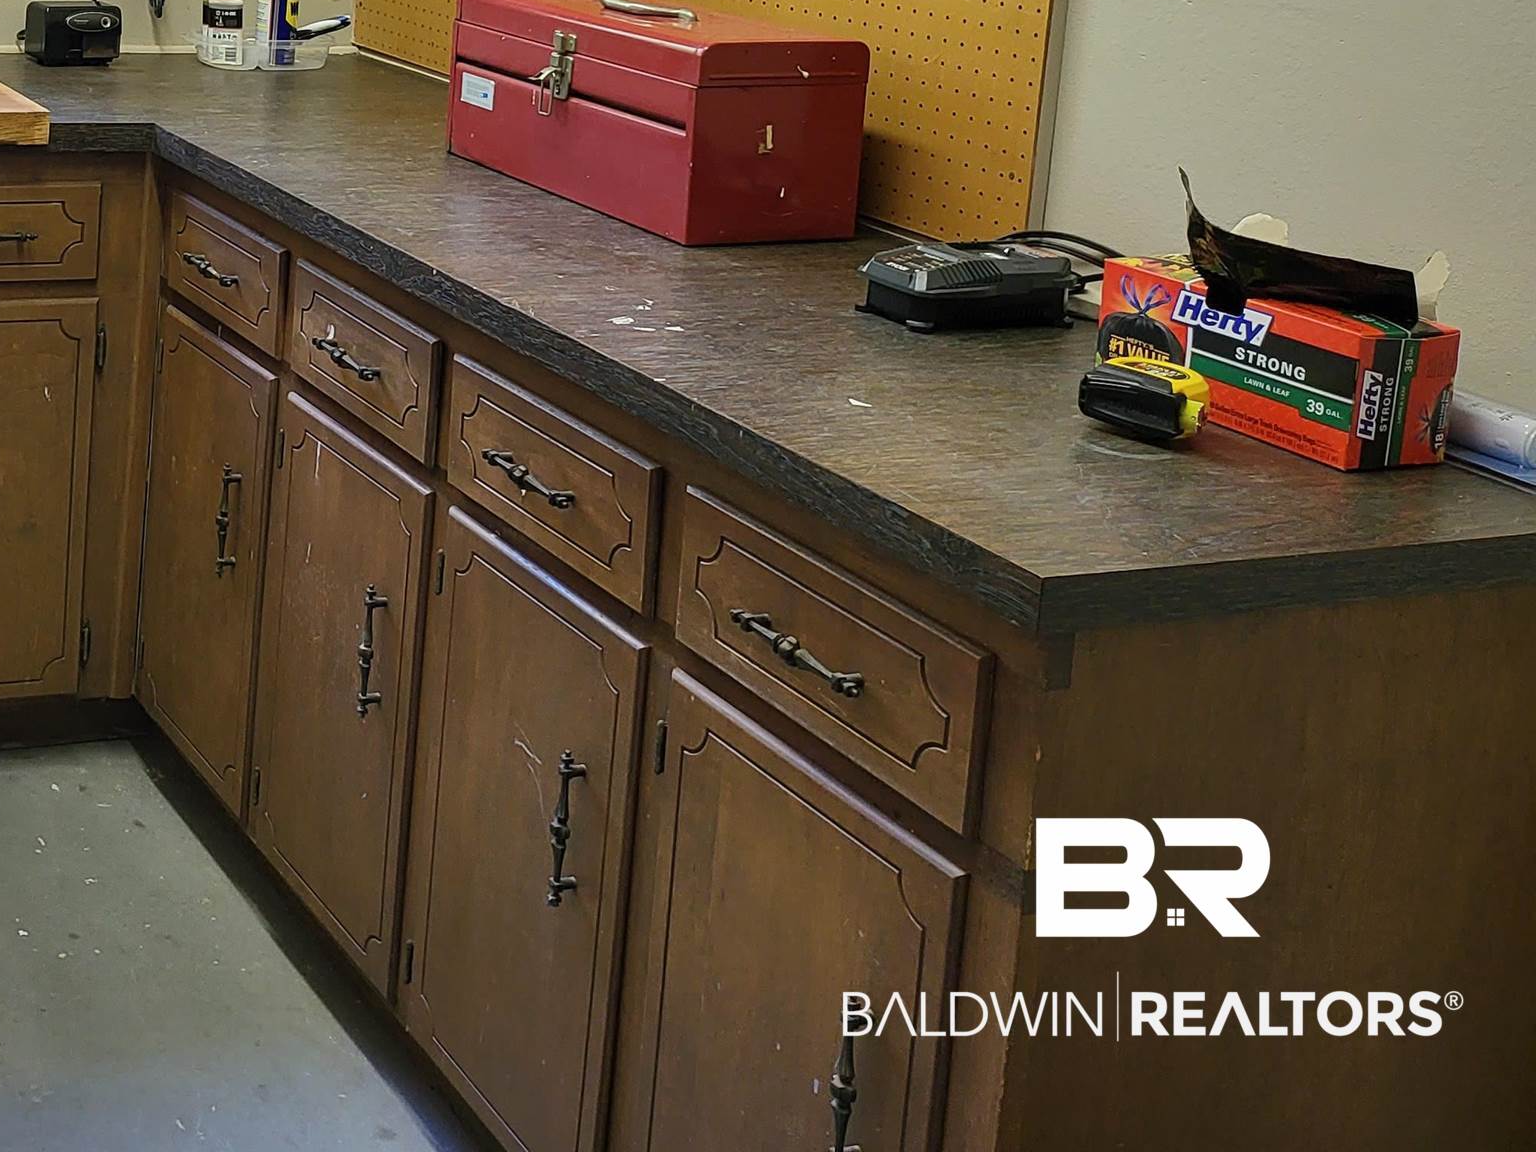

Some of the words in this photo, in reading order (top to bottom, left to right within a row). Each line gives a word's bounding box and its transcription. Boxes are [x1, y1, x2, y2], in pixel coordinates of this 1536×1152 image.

[1234, 346, 1306, 382] STRONG
[1404, 358, 1414, 372] 39
[1243, 376, 1264, 389] LAWN
[1272, 385, 1290, 397] LEAF
[1306, 398, 1325, 415] 39
[1359, 374, 1383, 436] Hefty
[1379, 377, 1394, 432] STRONG
[1434, 433, 1444, 449] 18
